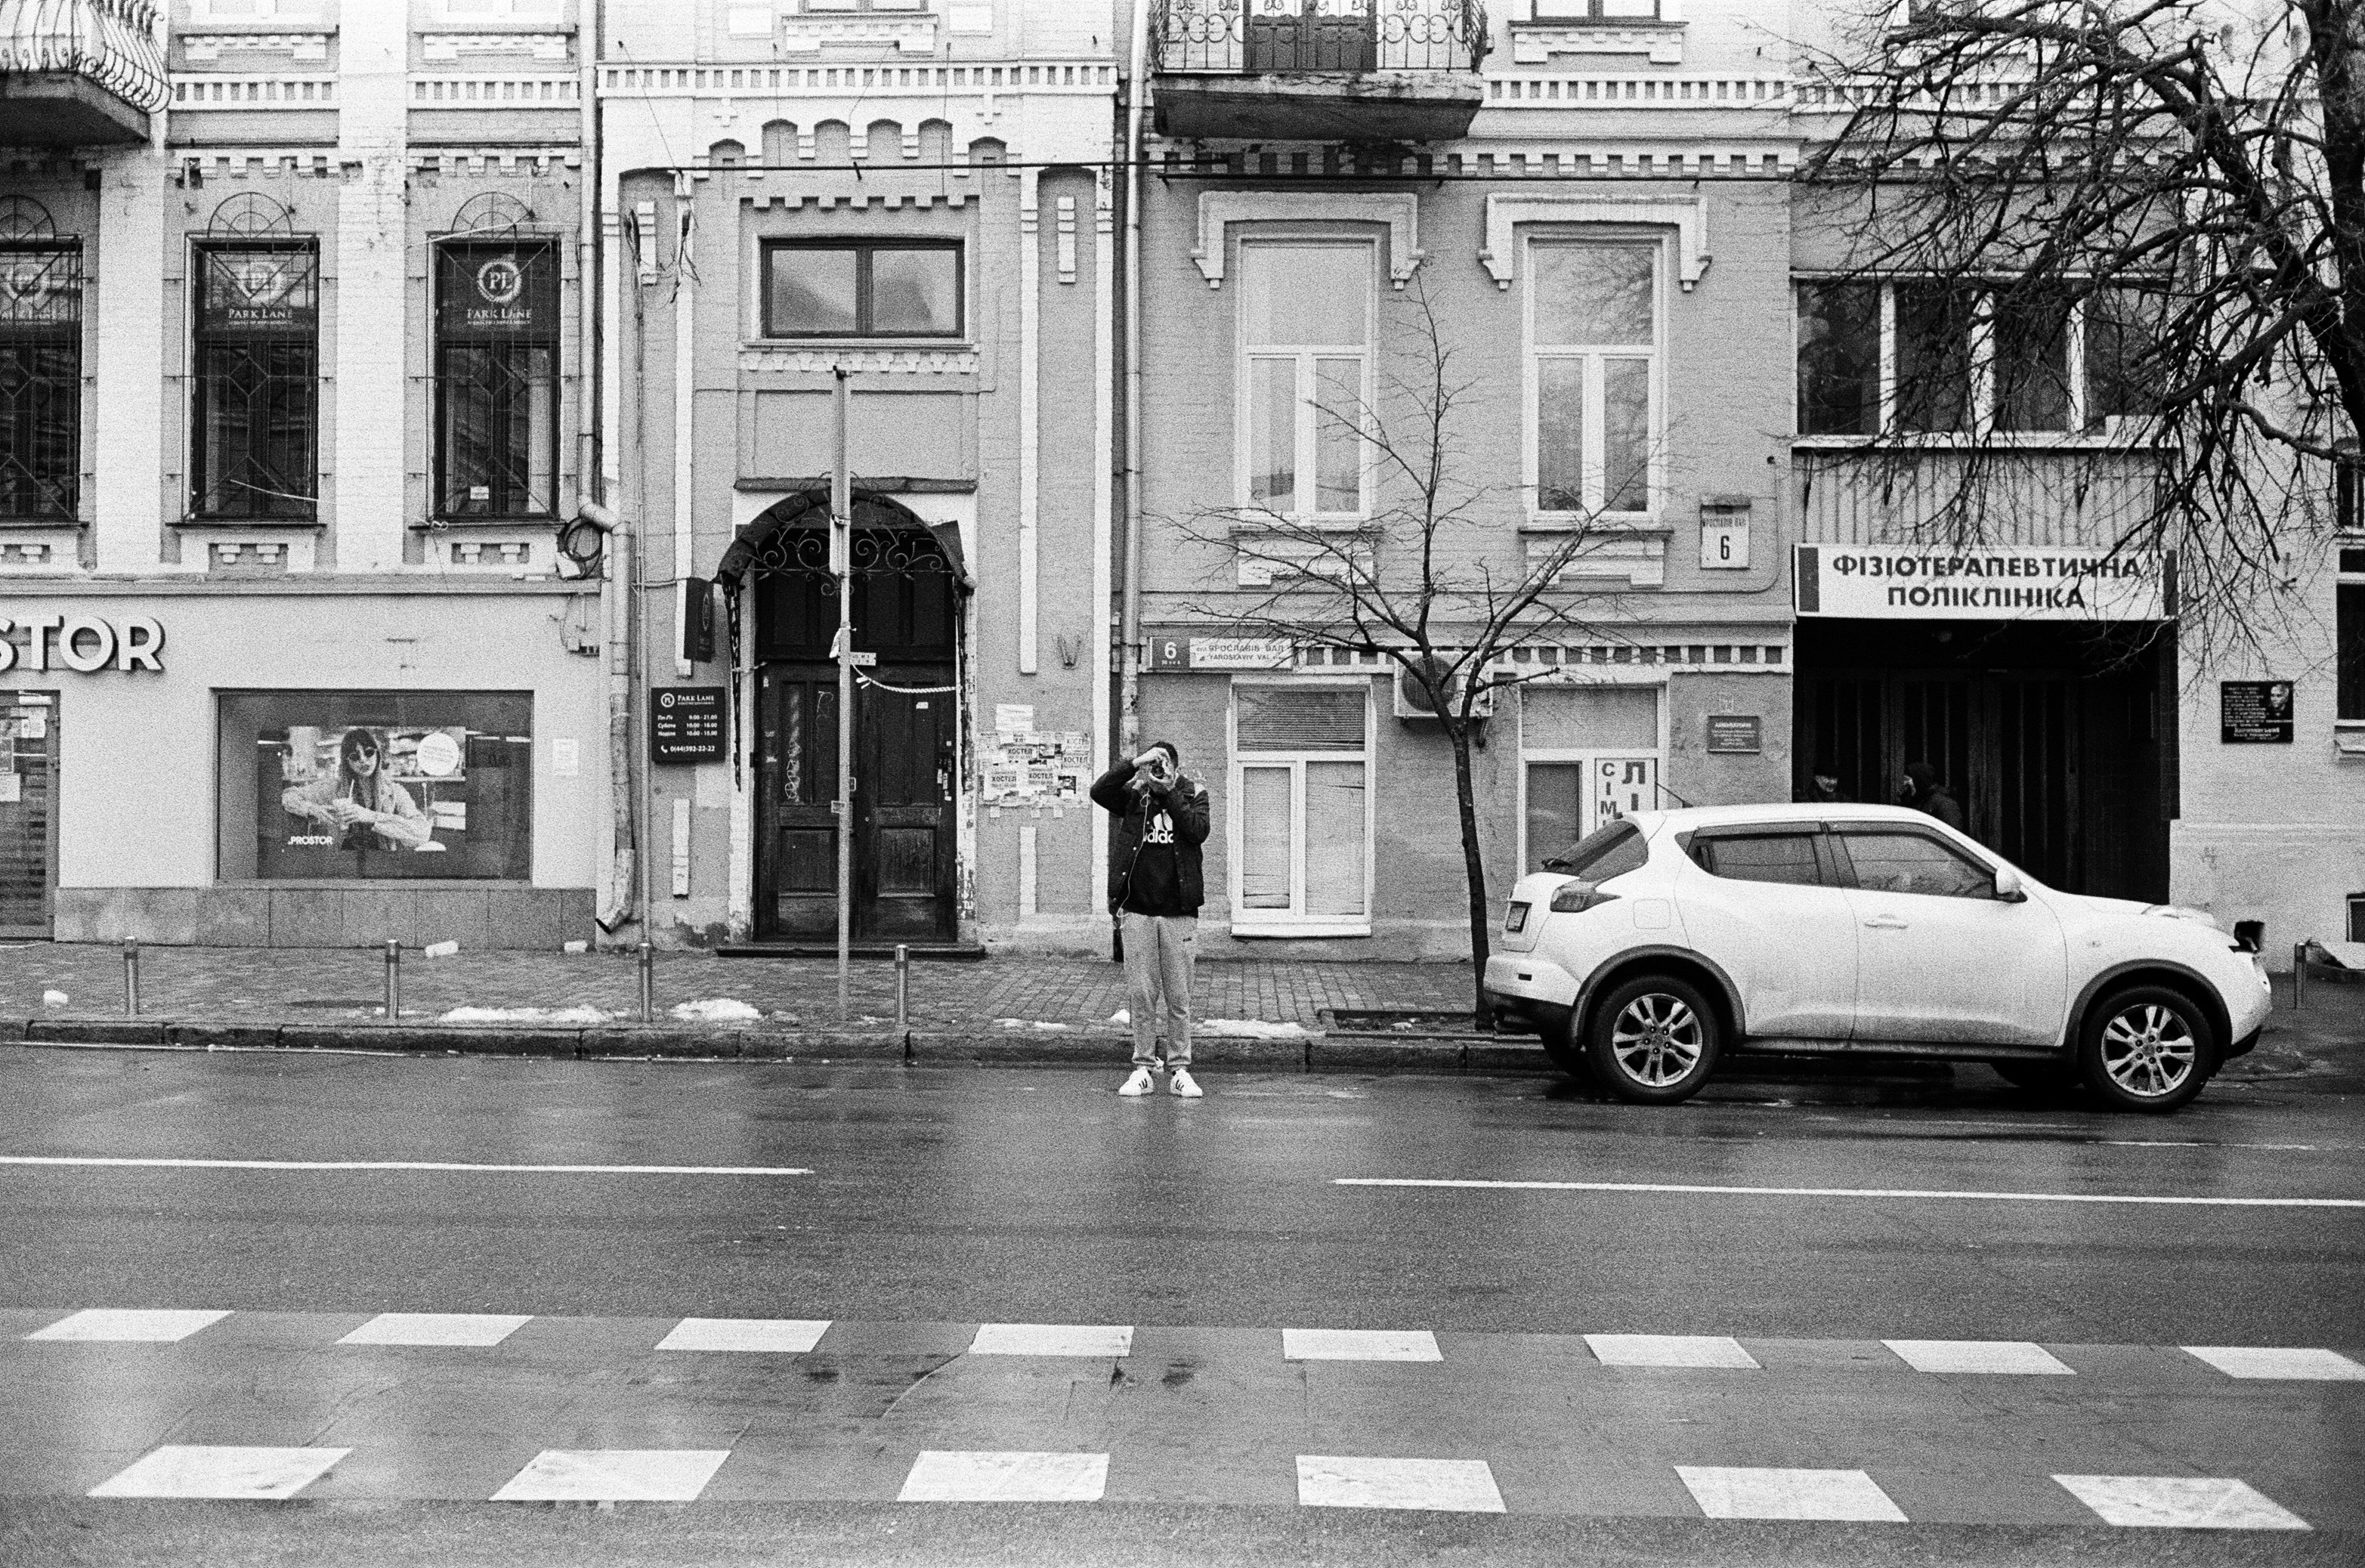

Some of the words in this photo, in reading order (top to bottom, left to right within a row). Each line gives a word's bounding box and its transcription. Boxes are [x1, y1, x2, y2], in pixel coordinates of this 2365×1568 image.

[229, 308, 258, 318] PARK
[262, 308, 292, 318] LANE
[1720, 535, 1730, 560] 6
[1833, 555, 2141, 578] ФІЗІОТЕРАПЕВТИЧНА
[1889, 586, 2085, 609] ПОЛІКЛІНІКА
[1164, 642, 1177, 659] 6
[1600, 762, 1617, 826] СІМ
